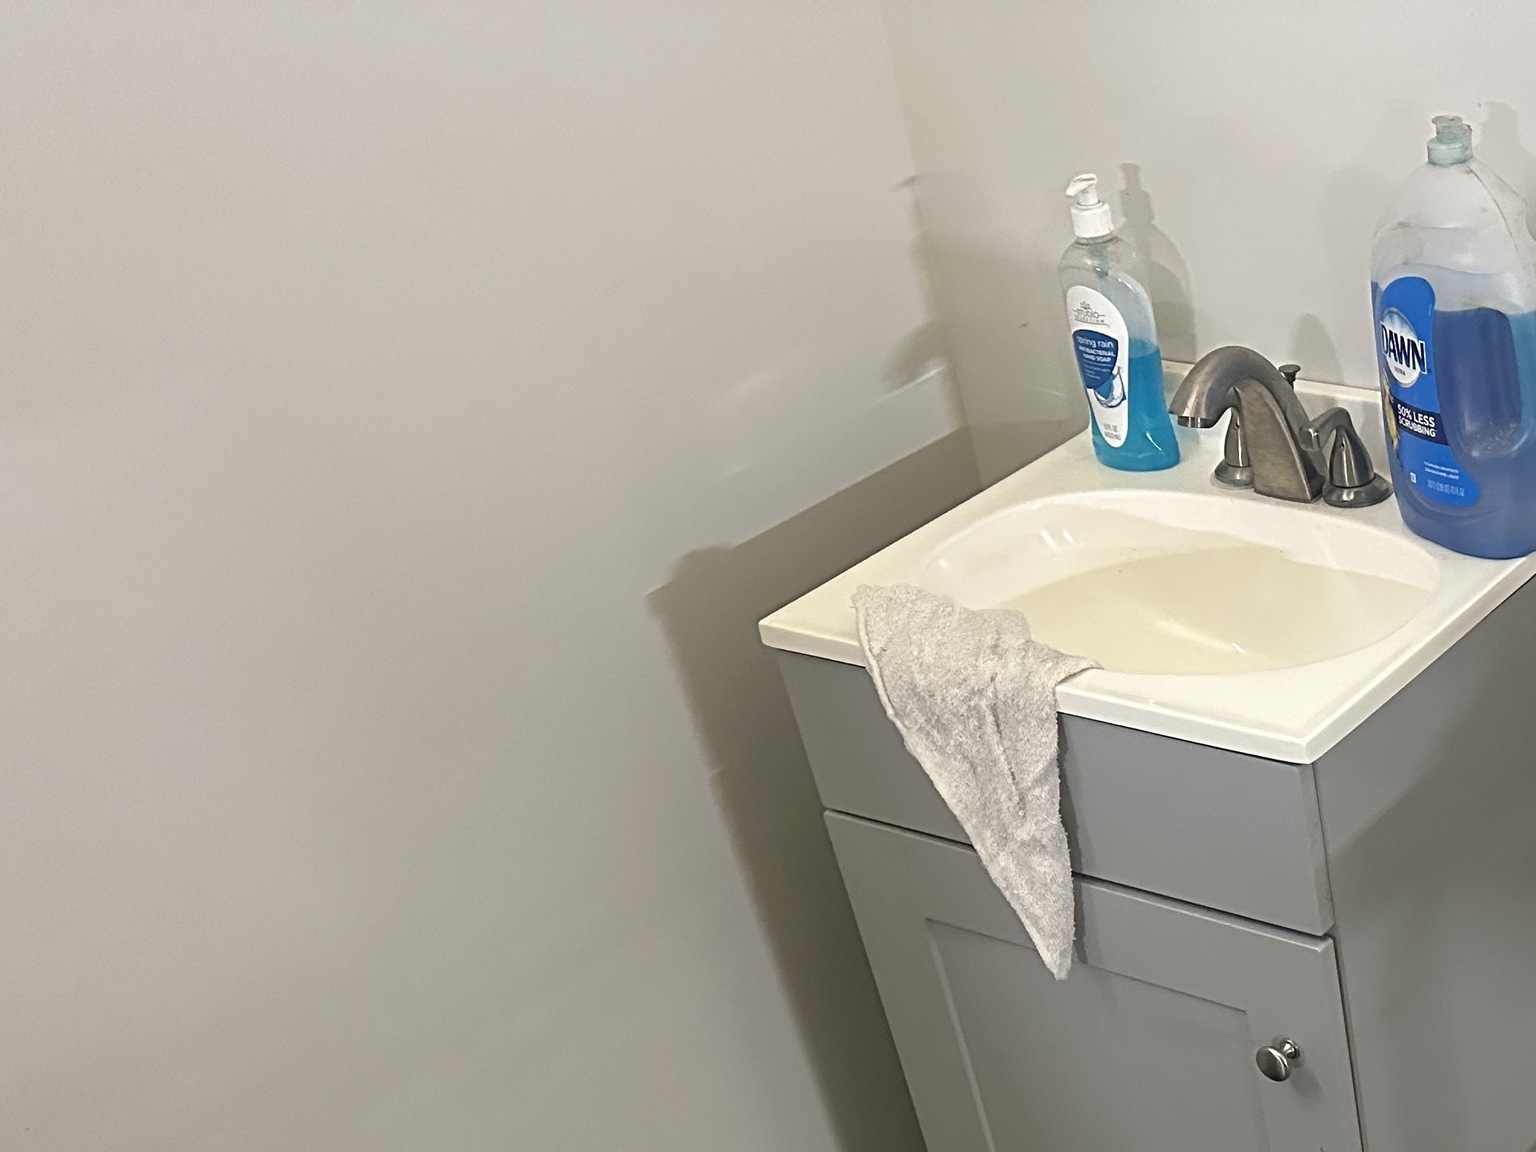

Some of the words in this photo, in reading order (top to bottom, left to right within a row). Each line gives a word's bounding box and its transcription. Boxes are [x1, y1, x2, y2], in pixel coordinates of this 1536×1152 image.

[1097, 340, 1114, 349] rain
[1380, 322, 1427, 373] DAWN
[1397, 403, 1412, 421] 50%
[1412, 411, 1436, 428] LESS
[1398, 415, 1437, 437] SCRUBBING
